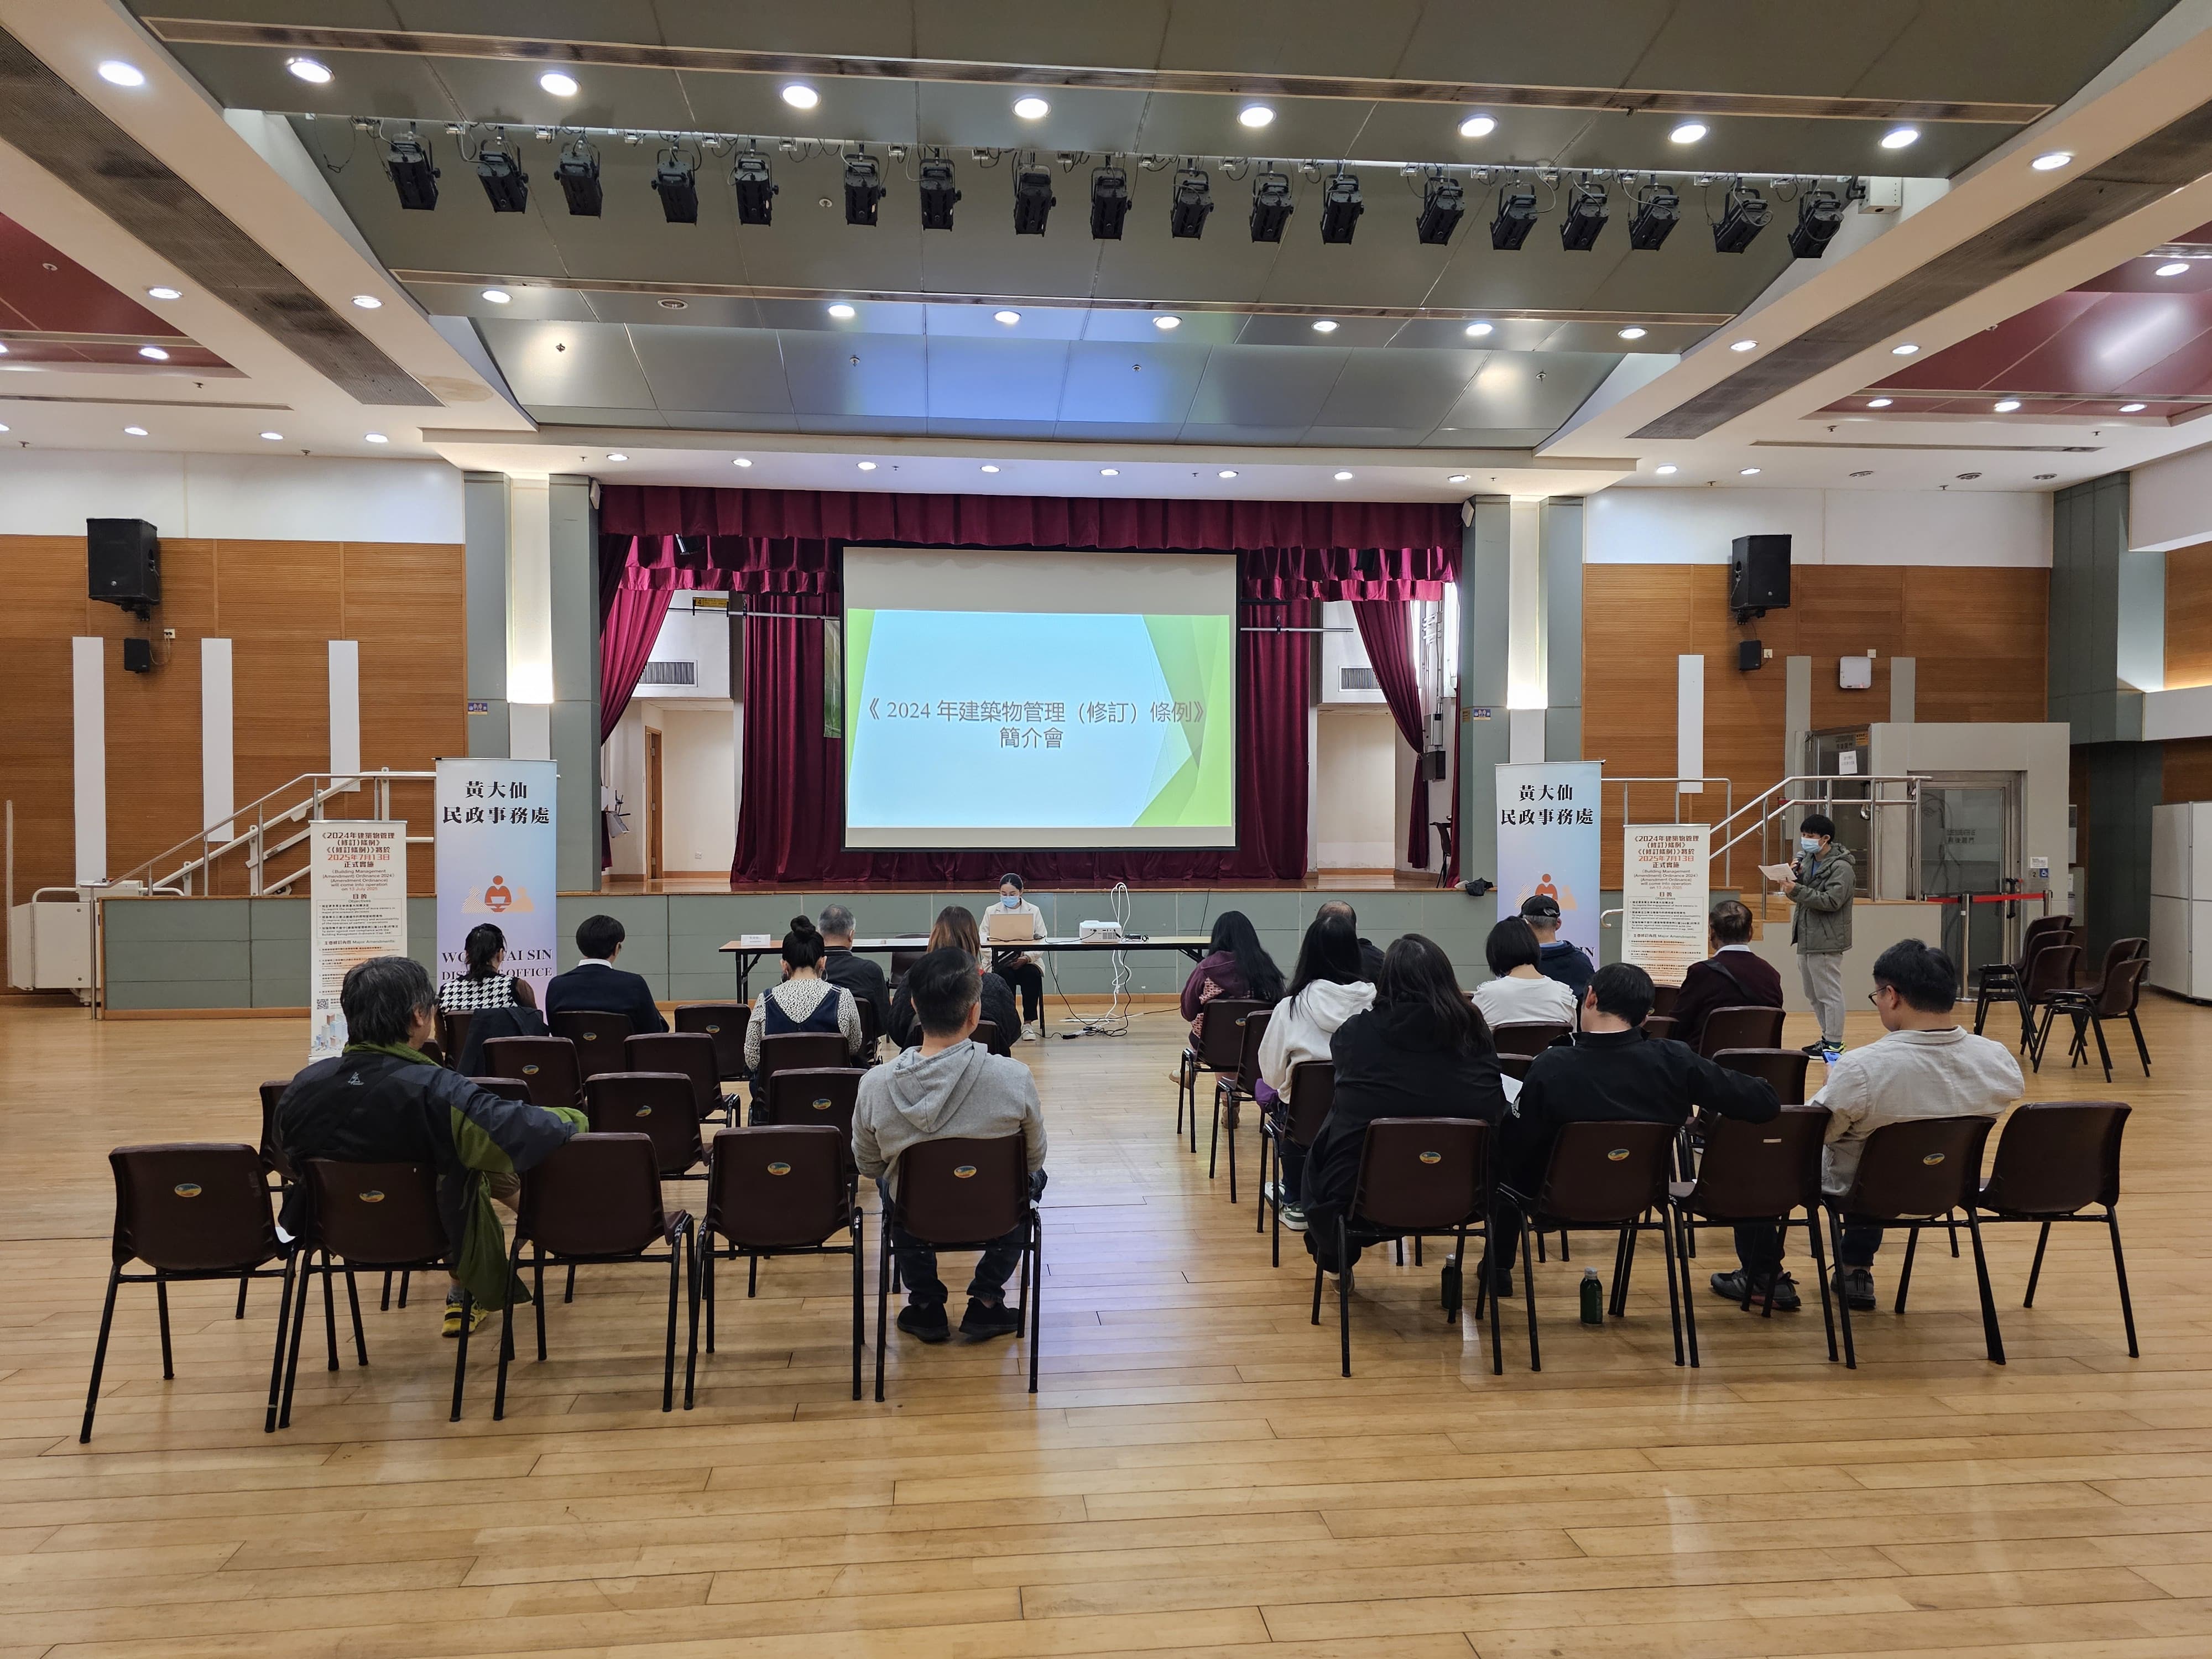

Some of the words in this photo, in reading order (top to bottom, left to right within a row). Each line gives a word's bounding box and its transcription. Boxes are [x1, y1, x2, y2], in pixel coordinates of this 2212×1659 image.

[887, 702, 931, 718] 2024
[1000, 727, 1063, 748] 簡介會
[443, 806, 550, 823] 民政事務處
[1501, 808, 1593, 825] 民政事務處
[527, 950, 552, 961] SIN
[506, 968, 552, 977] OFFICE
